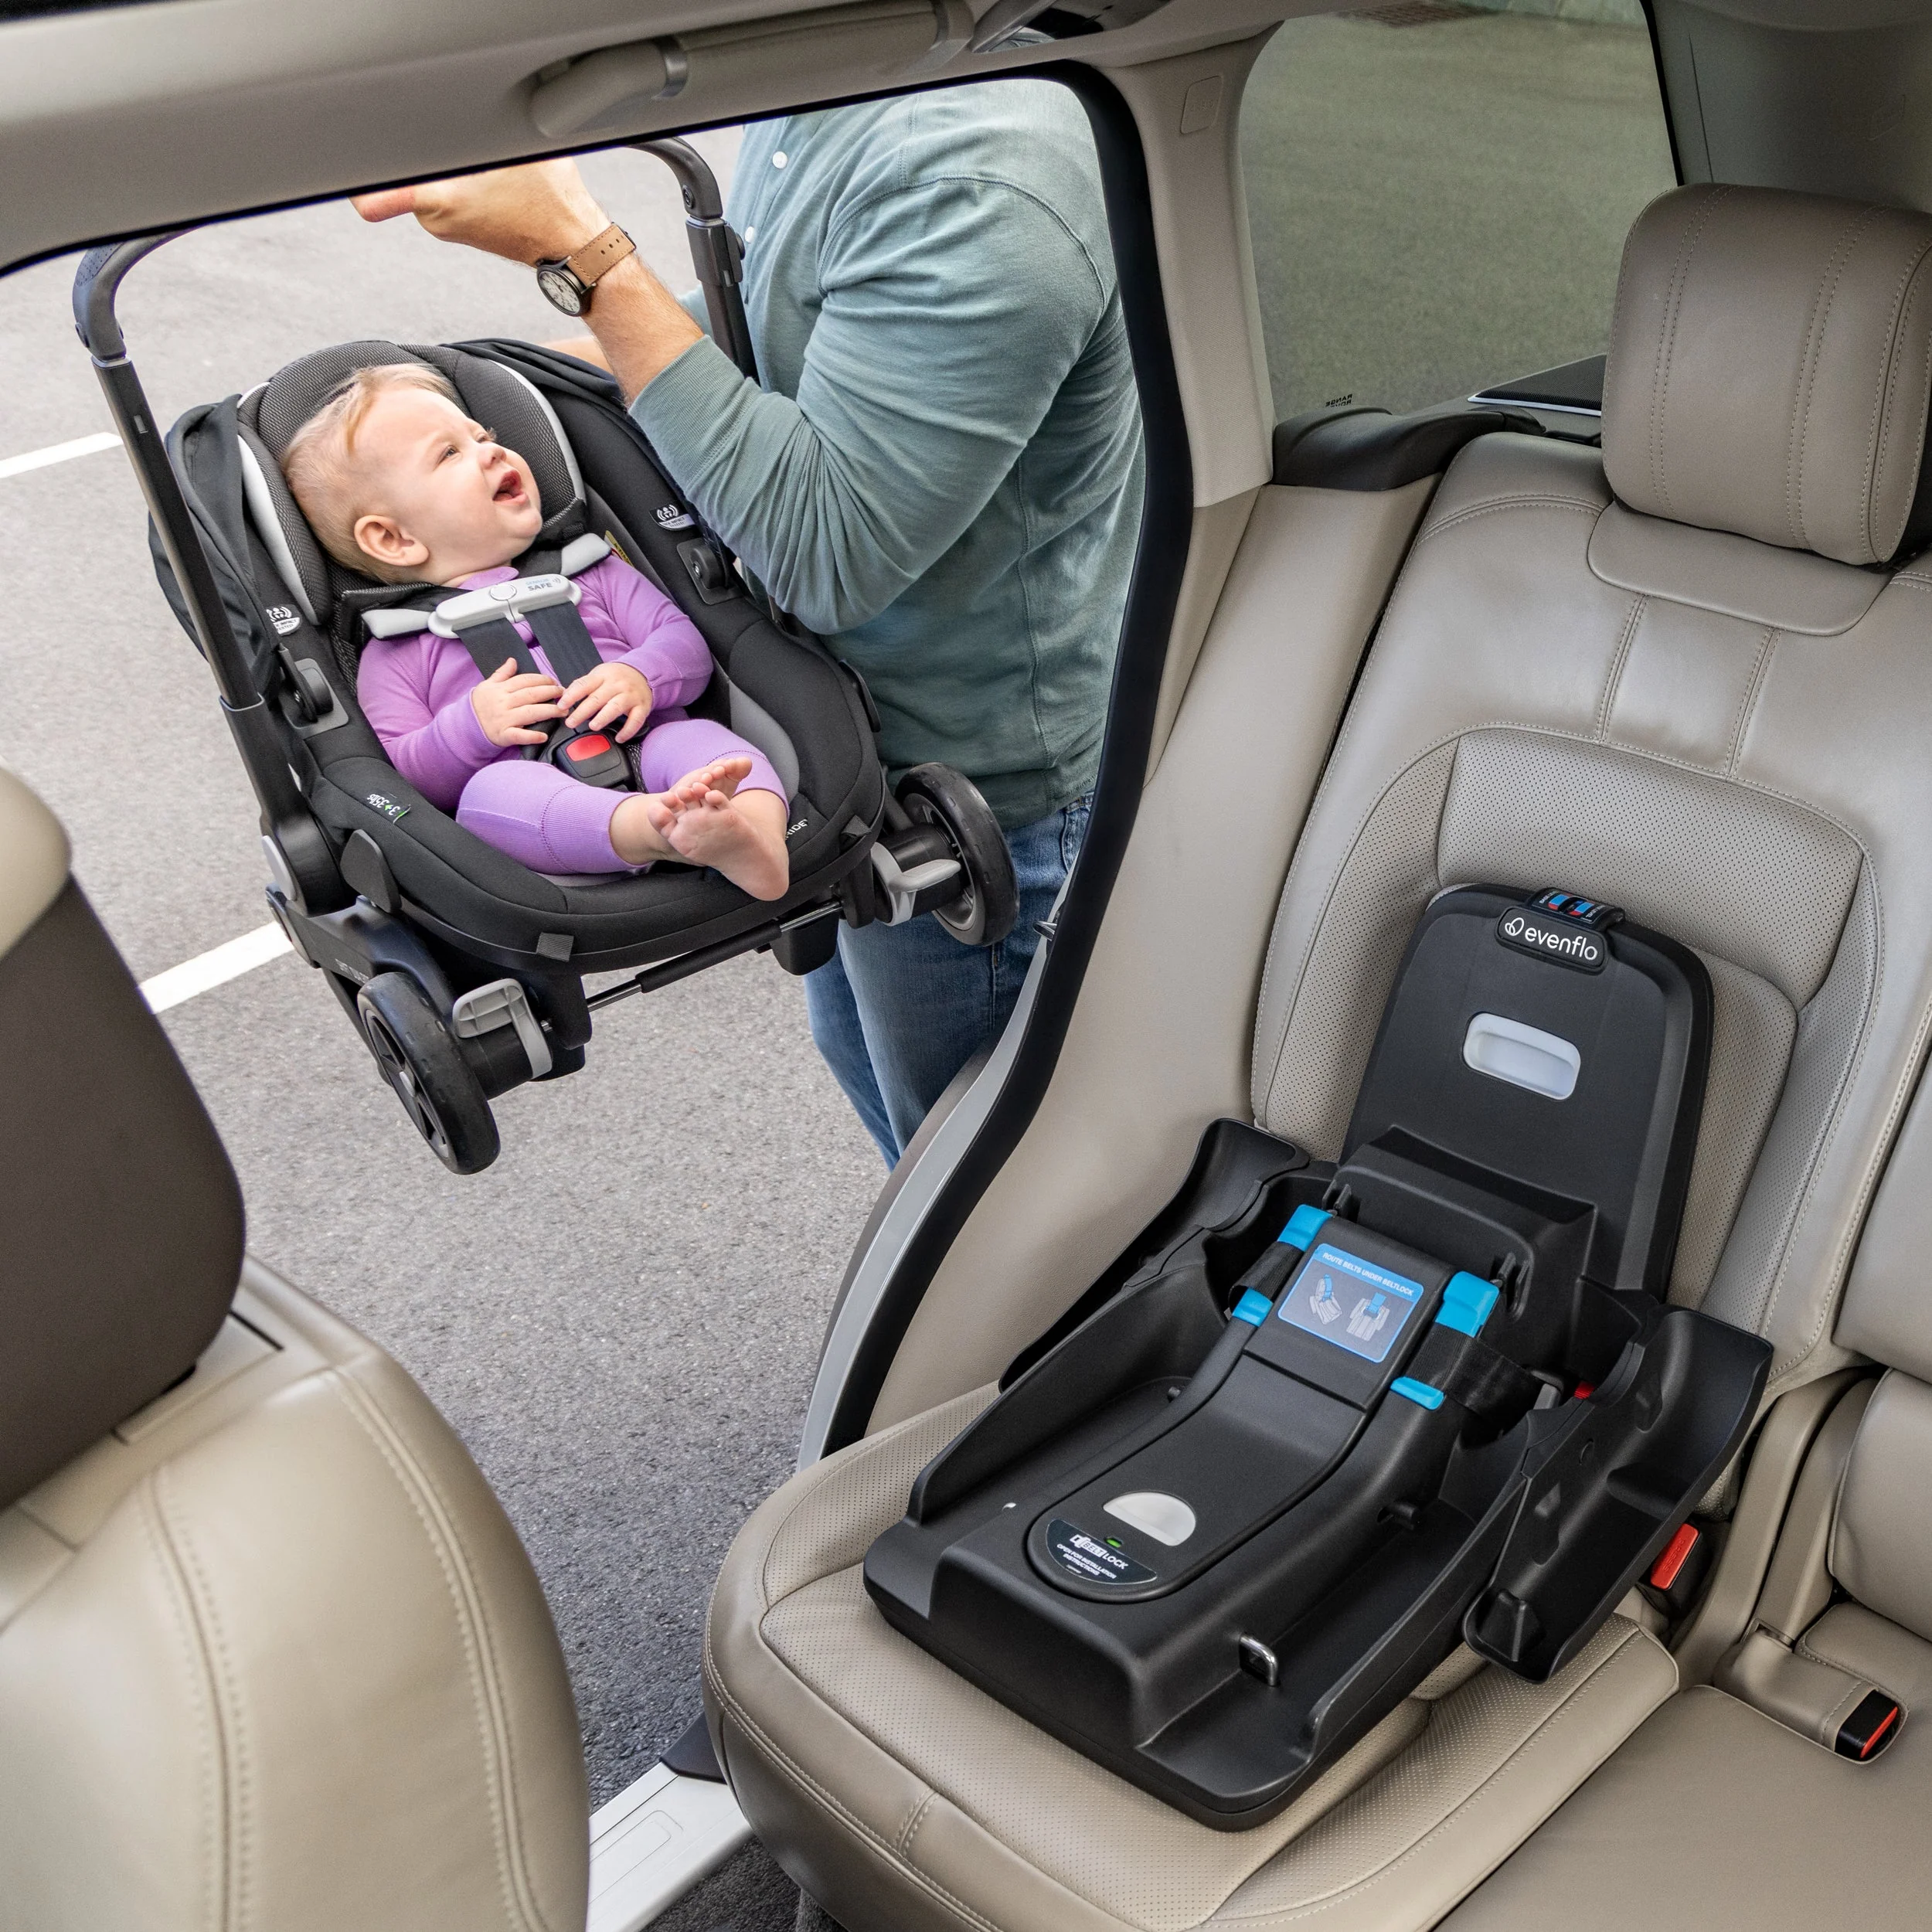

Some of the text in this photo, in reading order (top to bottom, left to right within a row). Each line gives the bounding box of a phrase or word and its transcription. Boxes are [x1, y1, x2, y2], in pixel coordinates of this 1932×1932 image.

[528, 582, 553, 591] SAFE
[366, 793, 390, 808] 35lbs
[785, 818, 808, 840] RIDE
[1525, 927, 1598, 961] evenflo
[1322, 1252, 1414, 1297] ROUTE BELTS UNDER BELTLOCK
[1063, 1553, 1100, 1576] INSTRUCTIONS
[1662, 1537, 1685, 1573] PRESS
[1080, 1556, 1117, 1579] INSTALLATION
